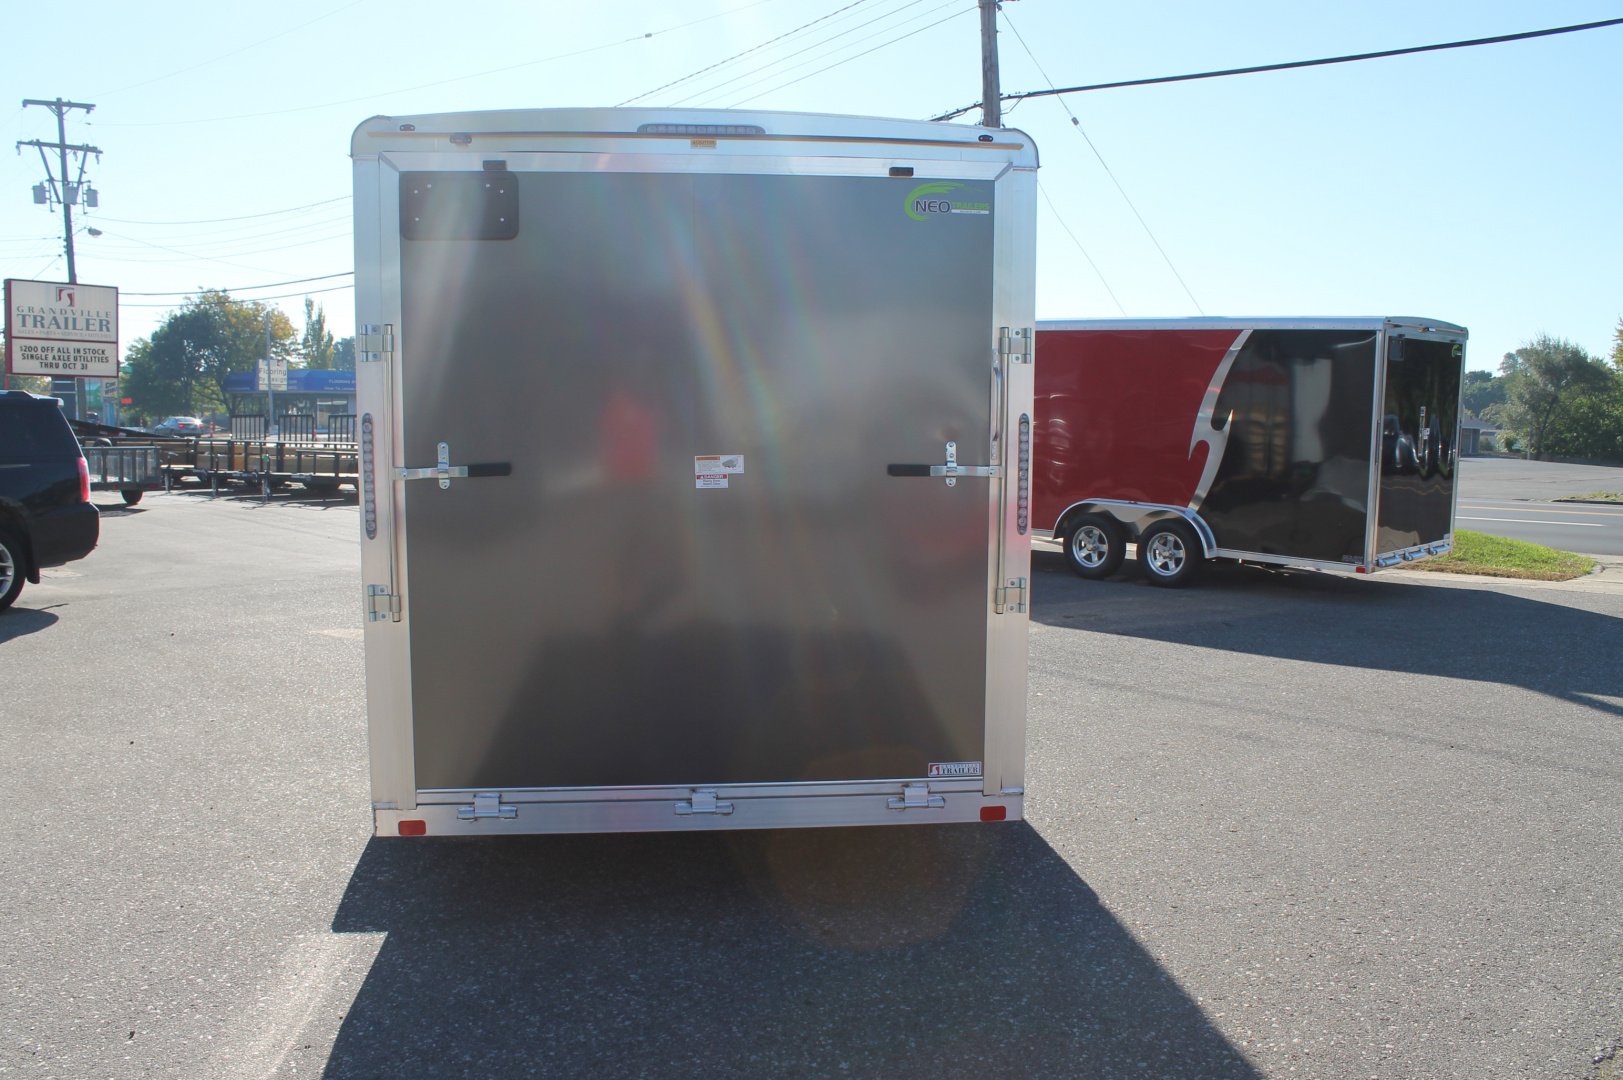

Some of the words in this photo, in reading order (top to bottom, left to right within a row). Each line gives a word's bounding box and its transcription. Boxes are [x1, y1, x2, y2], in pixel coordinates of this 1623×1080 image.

[915, 200, 950, 214] NEO
[951, 202, 990, 210] TRAILERS
[16, 306, 112, 318] GRANDVILLE
[16, 314, 111, 332] TRAILER
[259, 368, 286, 376] Flooring
